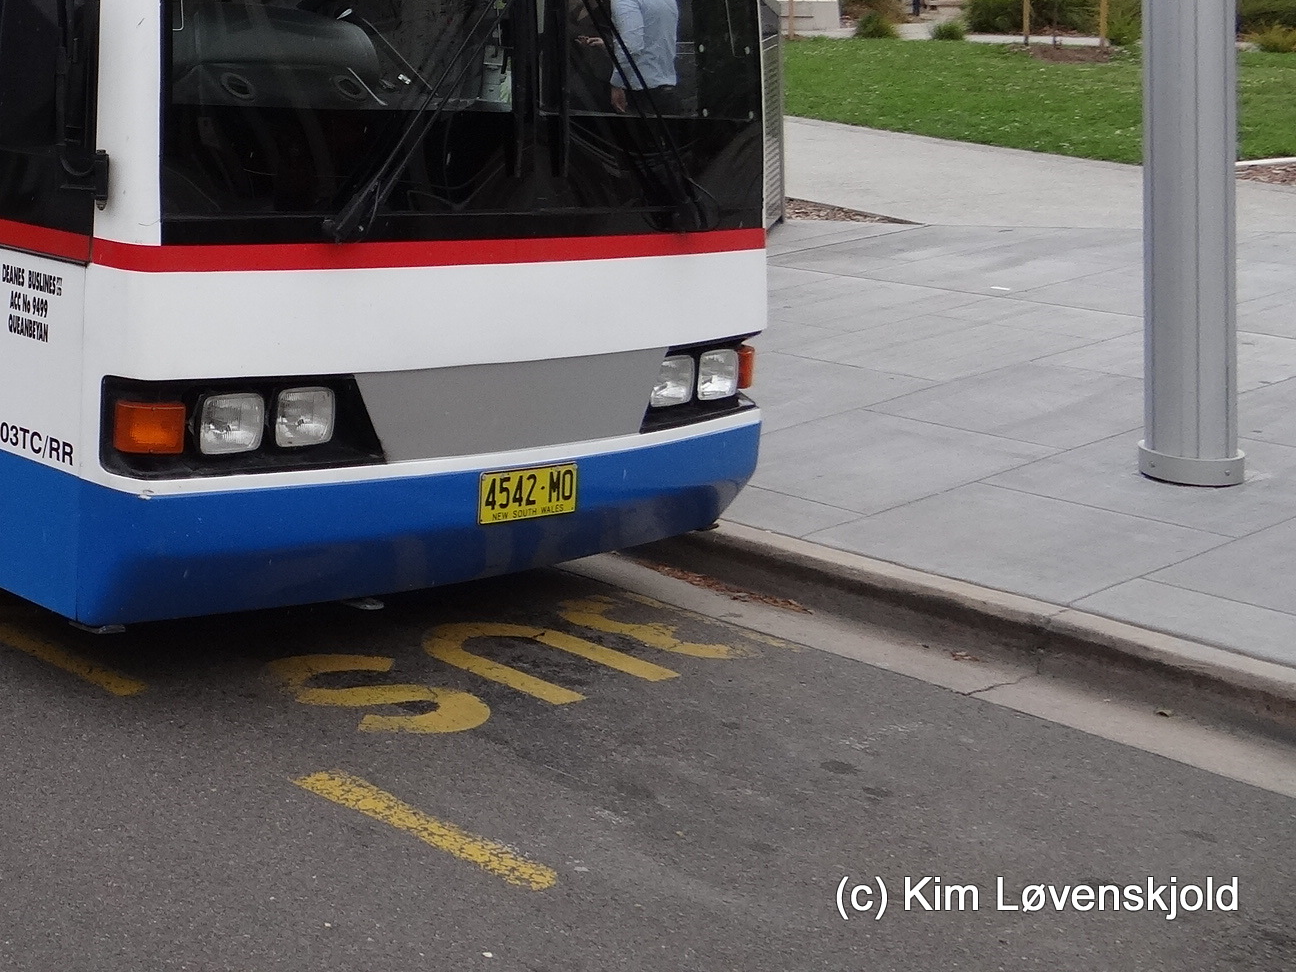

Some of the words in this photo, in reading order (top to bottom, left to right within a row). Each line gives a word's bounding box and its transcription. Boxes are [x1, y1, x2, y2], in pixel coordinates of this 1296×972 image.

[2, 263, 25, 288] DEANES
[28, 269, 56, 295] BUSLINES
[10, 290, 21, 311] ACC
[22, 293, 31, 314] No
[32, 296, 49, 318] 9499
[8, 313, 49, 343] QUEANBEYAN
[492, 511, 508, 521] NEW
[512, 508, 537, 519] SOUTH
[541, 504, 564, 514] WALES
